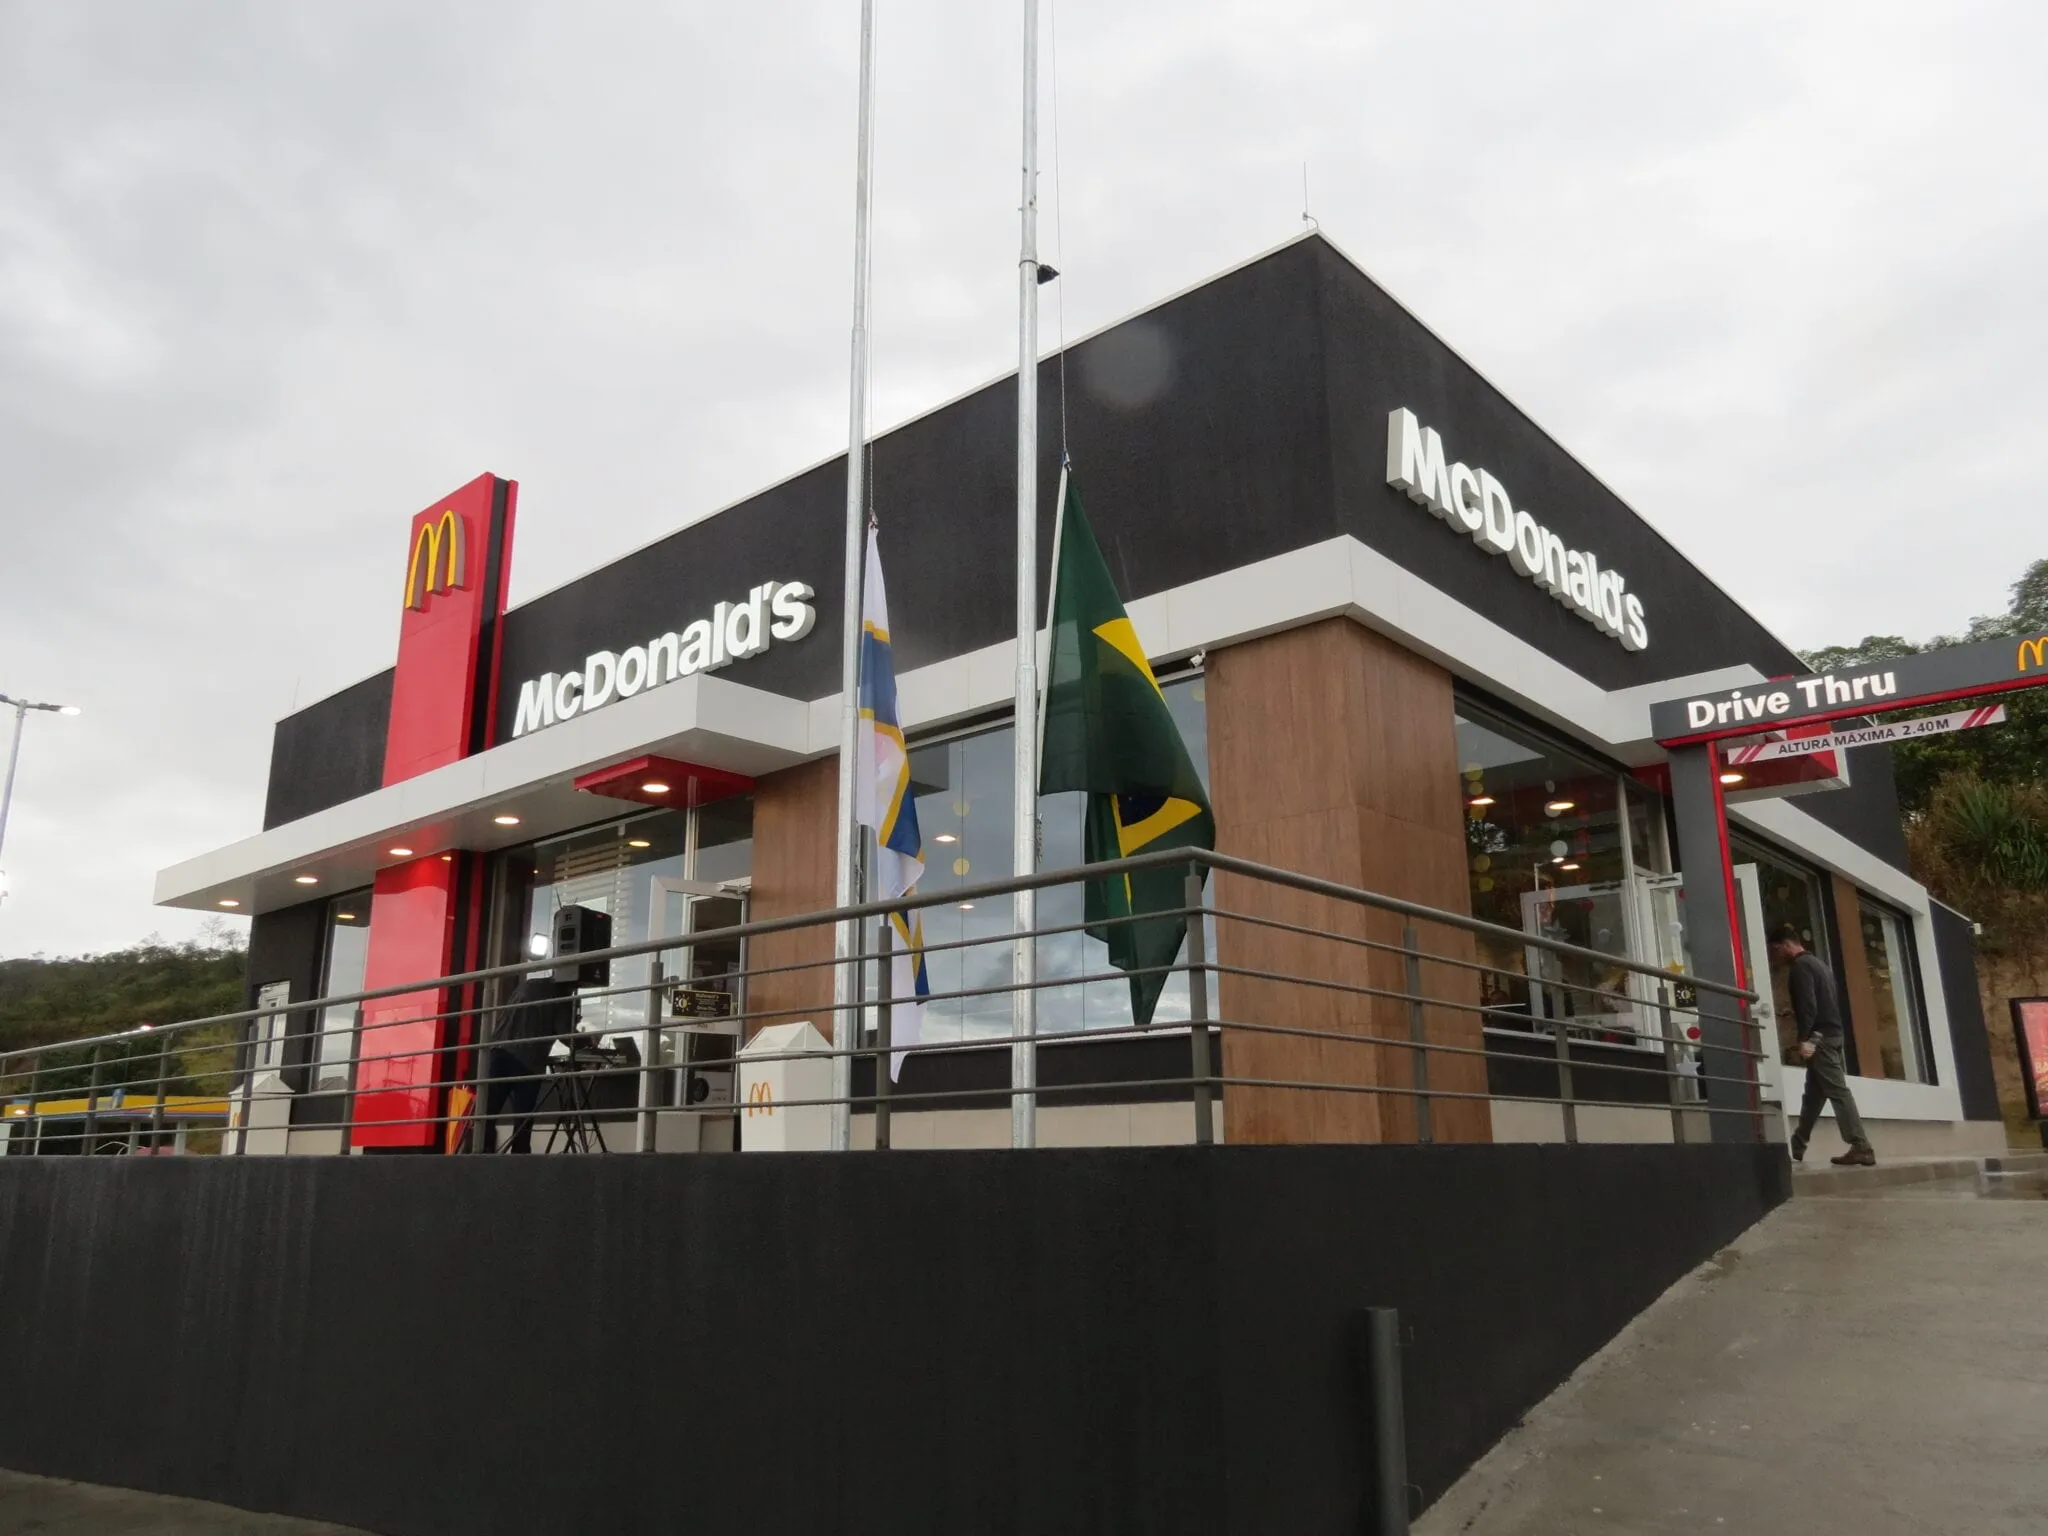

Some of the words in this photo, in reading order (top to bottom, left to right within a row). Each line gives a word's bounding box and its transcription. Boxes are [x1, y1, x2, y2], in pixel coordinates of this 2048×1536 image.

[1387, 407, 1648, 651] McDonald's
[512, 580, 815, 738] McDonald's
[1687, 690, 1791, 729] Drive
[1796, 671, 1897, 708] Thru
[1778, 738, 1831, 755] ALTURA
